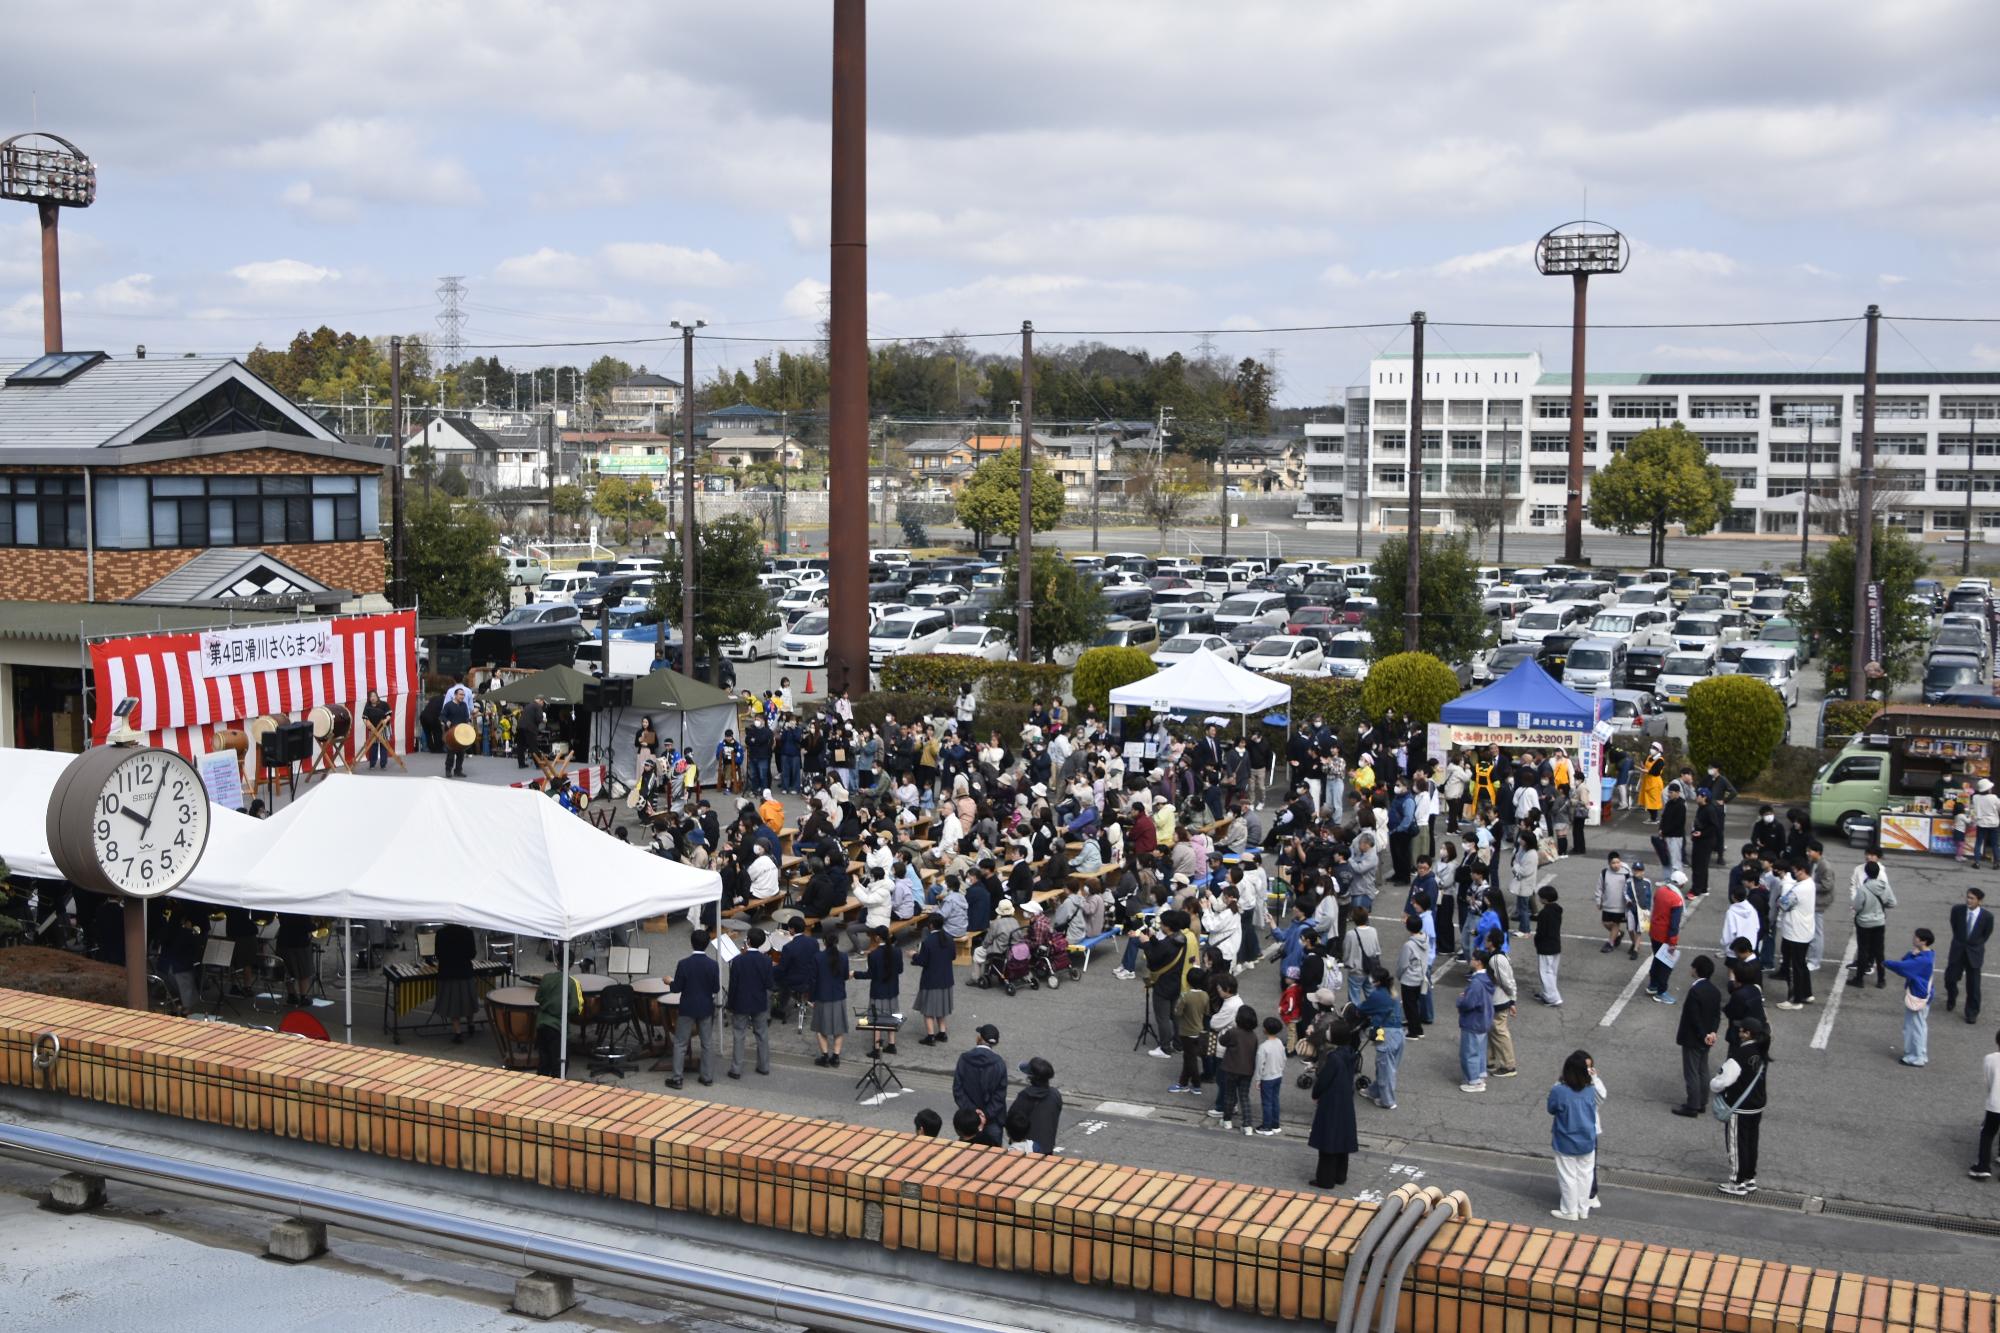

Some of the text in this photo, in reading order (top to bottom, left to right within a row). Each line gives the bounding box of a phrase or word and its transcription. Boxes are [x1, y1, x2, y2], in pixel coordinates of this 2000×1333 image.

[209, 632, 326, 666] 第4回滑川さくらまつり
[118, 771, 132, 794] 11
[136, 763, 153, 786] 12
[172, 780, 184, 801] 2
[101, 793, 120, 815] 10
[178, 804, 191, 825] 3
[97, 819, 111, 841] 9
[173, 828, 187, 848] 4
[105, 841, 119, 862] 8
[160, 849, 173, 870] 5
[121, 857, 135, 879] 7
[140, 859, 154, 880] 6
